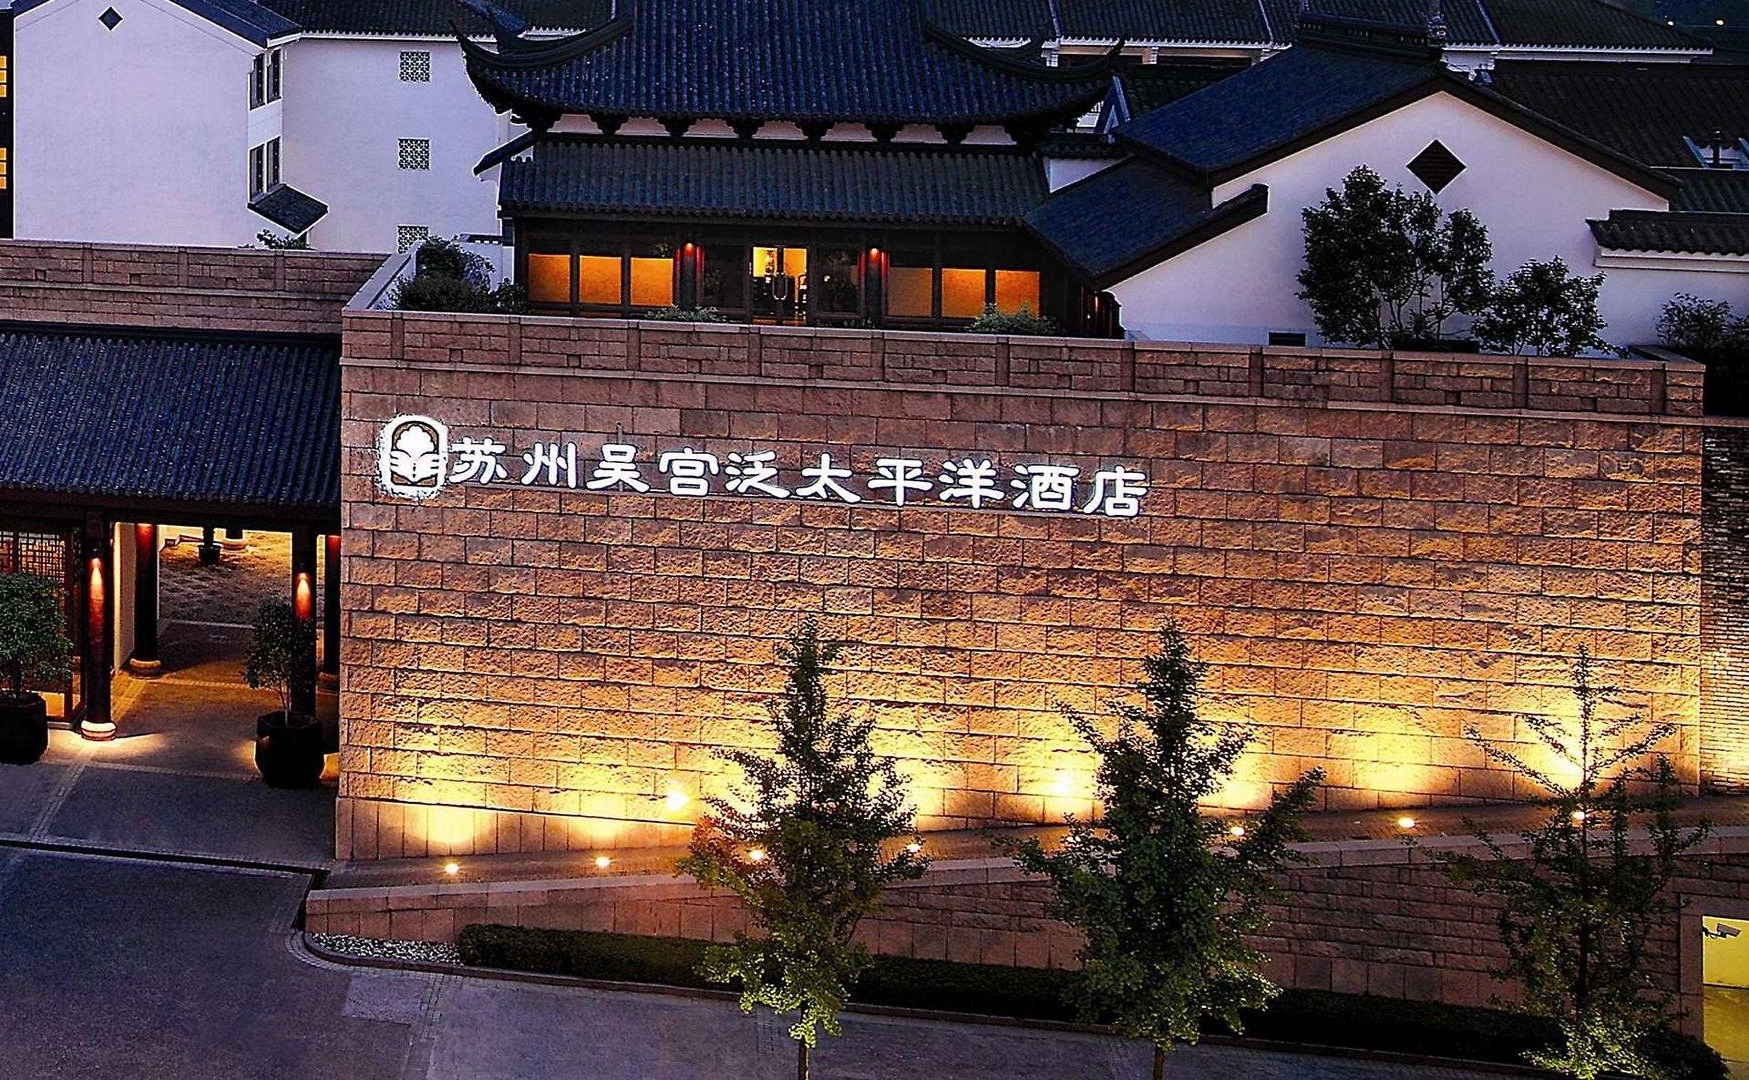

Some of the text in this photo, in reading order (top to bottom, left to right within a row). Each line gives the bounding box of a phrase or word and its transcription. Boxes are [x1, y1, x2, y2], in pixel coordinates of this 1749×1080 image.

[449, 436, 1149, 517] 苏州吴宫泛太平洋酒店
